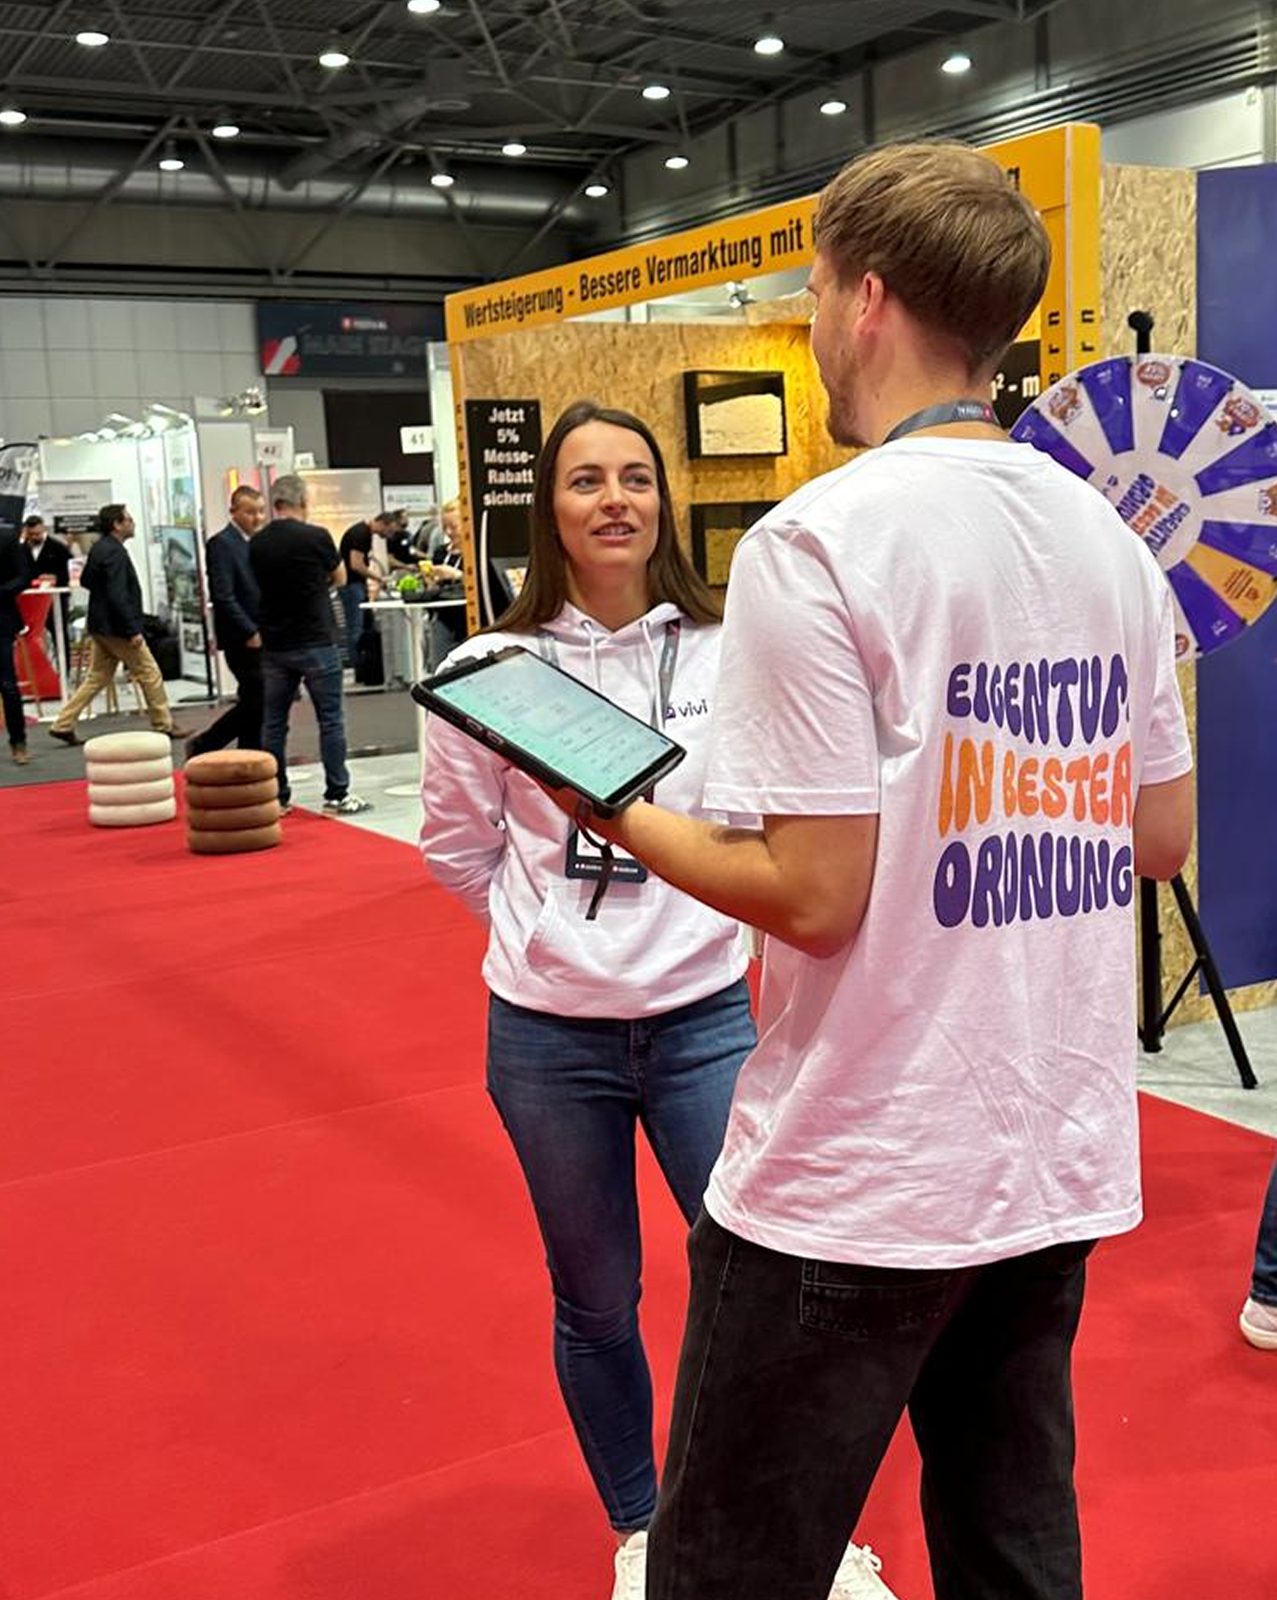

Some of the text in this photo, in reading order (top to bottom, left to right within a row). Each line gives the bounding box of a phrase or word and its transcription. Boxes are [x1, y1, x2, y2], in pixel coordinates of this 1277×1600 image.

[463, 286, 565, 329] Wertsteigerung
[579, 266, 641, 301] Bessere
[646, 233, 762, 284] Vermarktung
[770, 217, 804, 258] mit
[488, 407, 525, 424] Jetzt
[497, 427, 520, 443] 5%
[483, 448, 535, 464] Messe-
[488, 468, 534, 484] Rabatt
[677, 699, 708, 718] vivi
[938, 730, 995, 839] IN
[933, 831, 1133, 929] ORDNUNG
